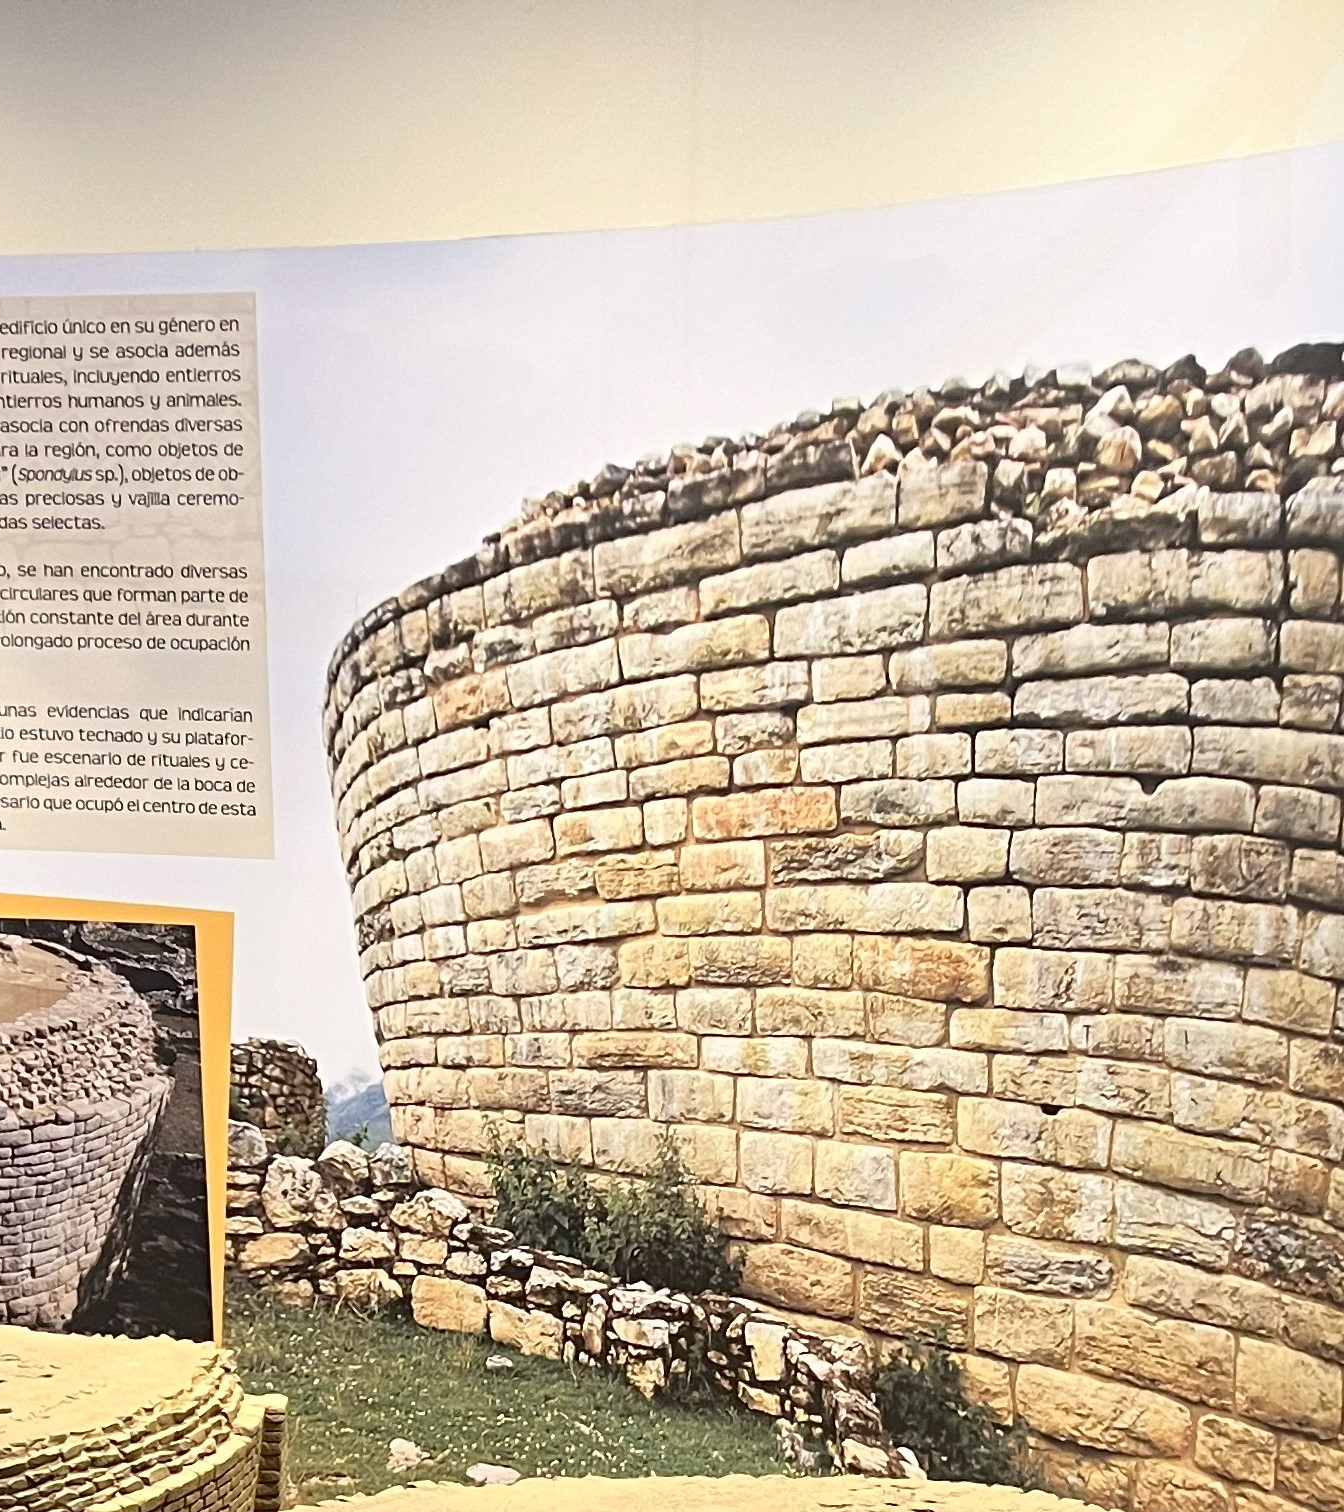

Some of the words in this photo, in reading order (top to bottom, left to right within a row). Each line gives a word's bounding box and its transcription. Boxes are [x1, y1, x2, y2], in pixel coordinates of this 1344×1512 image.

[0, 319, 59, 335] edificio
[62, 318, 107, 335] único
[110, 321, 131, 335] en
[134, 320, 155, 334] su
[158, 317, 216, 336] género
[219, 318, 240, 332] en
[1, 345, 67, 363] regional
[72, 346, 84, 362] y
[89, 345, 110, 359] se
[115, 343, 169, 360] asocia
[174, 340, 241, 358] además
[0, 369, 68, 387] rituales,
[73, 368, 161, 386] incluyendo
[165, 367, 241, 383] entierros
[67, 393, 145, 409] humanos
[149, 395, 161, 411] y
[165, 392, 243, 408] animales.
[0, 418, 54, 434] asocia
[58, 420, 89, 433] con
[94, 418, 170, 433] ofrendas
[174, 417, 243, 433] diversas
[24, 443, 39, 458] la
[44, 441, 100, 460] región,
[105, 444, 153, 458] como
[157, 442, 219, 460] objetos
[223, 442, 244, 457] de
[25, 491, 105, 508] preciosas
[111, 493, 122, 509] y
[127, 491, 171, 508] vajilla
[177, 493, 245, 506] ceremo-
[31, 515, 106, 530] selectas.
[17, 564, 37, 578] se
[43, 563, 74, 578] han
[80, 564, 174, 579] encontrado
[180, 564, 248, 580] diversas
[0, 586, 79, 602] circulares
[82, 589, 113, 604] que
[117, 587, 177, 603] forman
[180, 589, 225, 605] parte
[228, 589, 249, 604] de
[29, 611, 114, 626] constante
[117, 611, 141, 626] del
[145, 611, 182, 627] área
[185, 612, 250, 628] durante
[47, 704, 130, 720] evidencias
[139, 708, 169, 722] que
[178, 707, 253, 723] indicarían
[19, 727, 74, 742] estuvo
[78, 728, 144, 744] techado
[147, 731, 158, 746] y
[161, 731, 181, 745] su
[185, 731, 253, 747] platafor-
